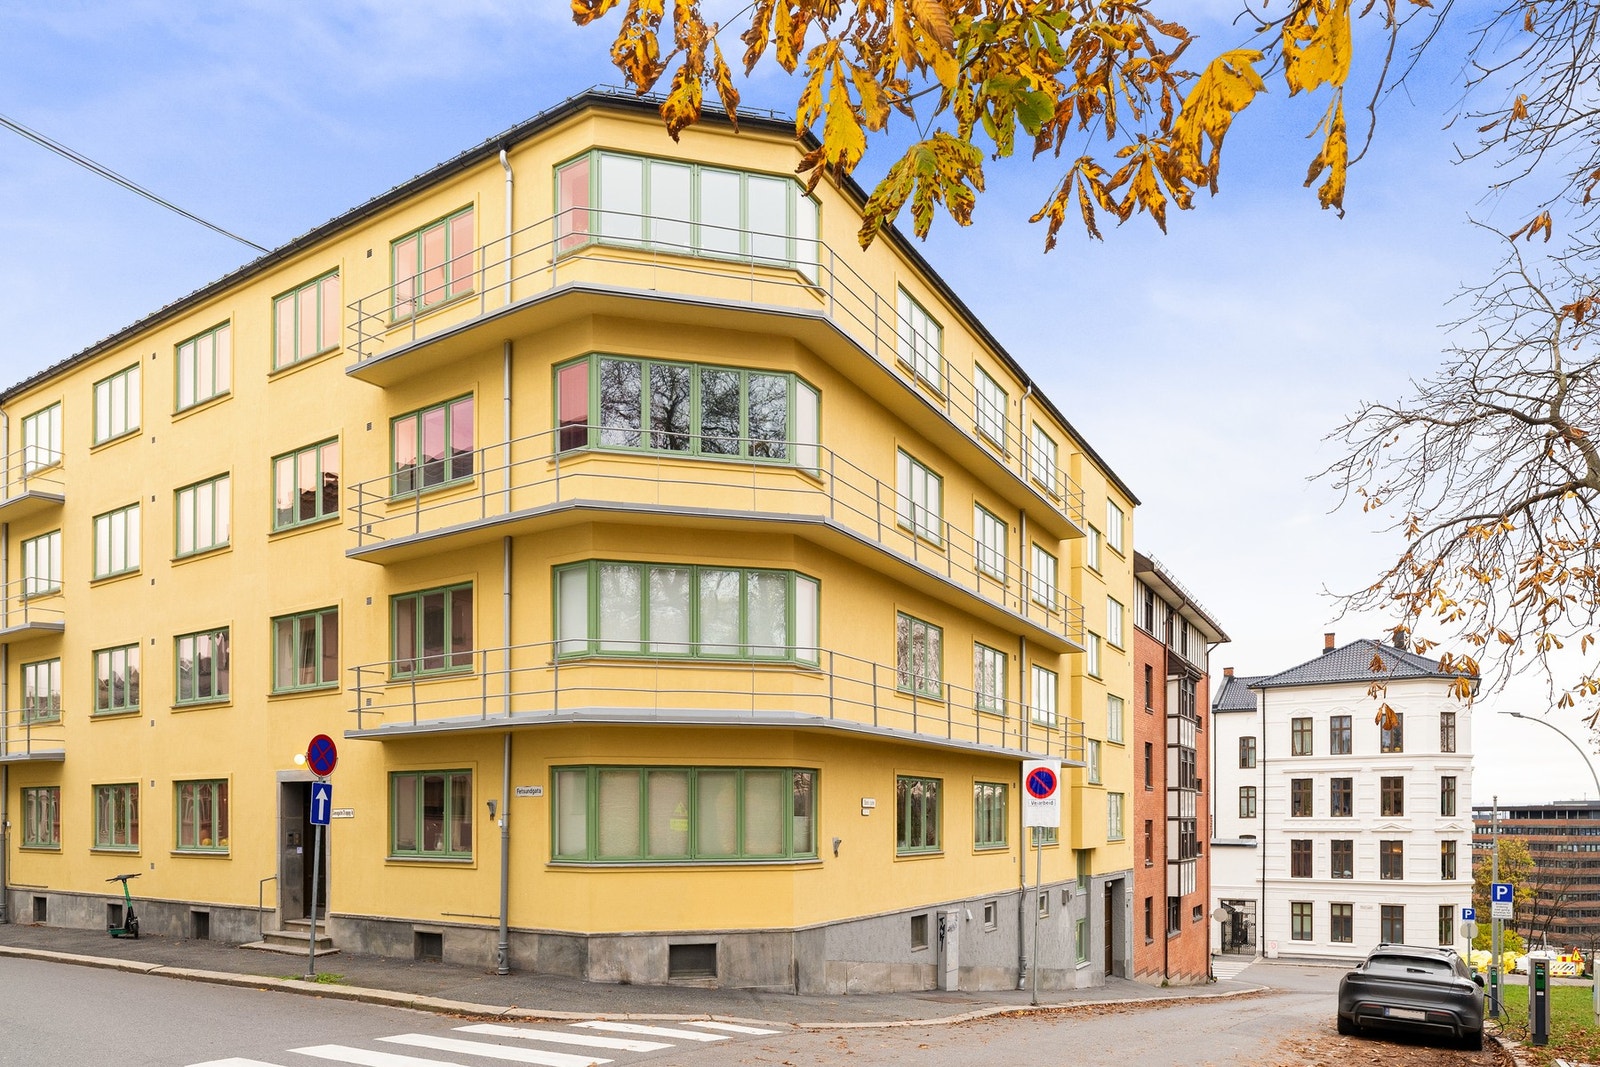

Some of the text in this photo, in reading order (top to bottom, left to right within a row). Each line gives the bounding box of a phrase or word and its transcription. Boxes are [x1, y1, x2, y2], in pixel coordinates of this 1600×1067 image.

[516, 787, 542, 796] Fetsundgata
[1496, 885, 1508, 900] P
[1465, 909, 1472, 919] P
